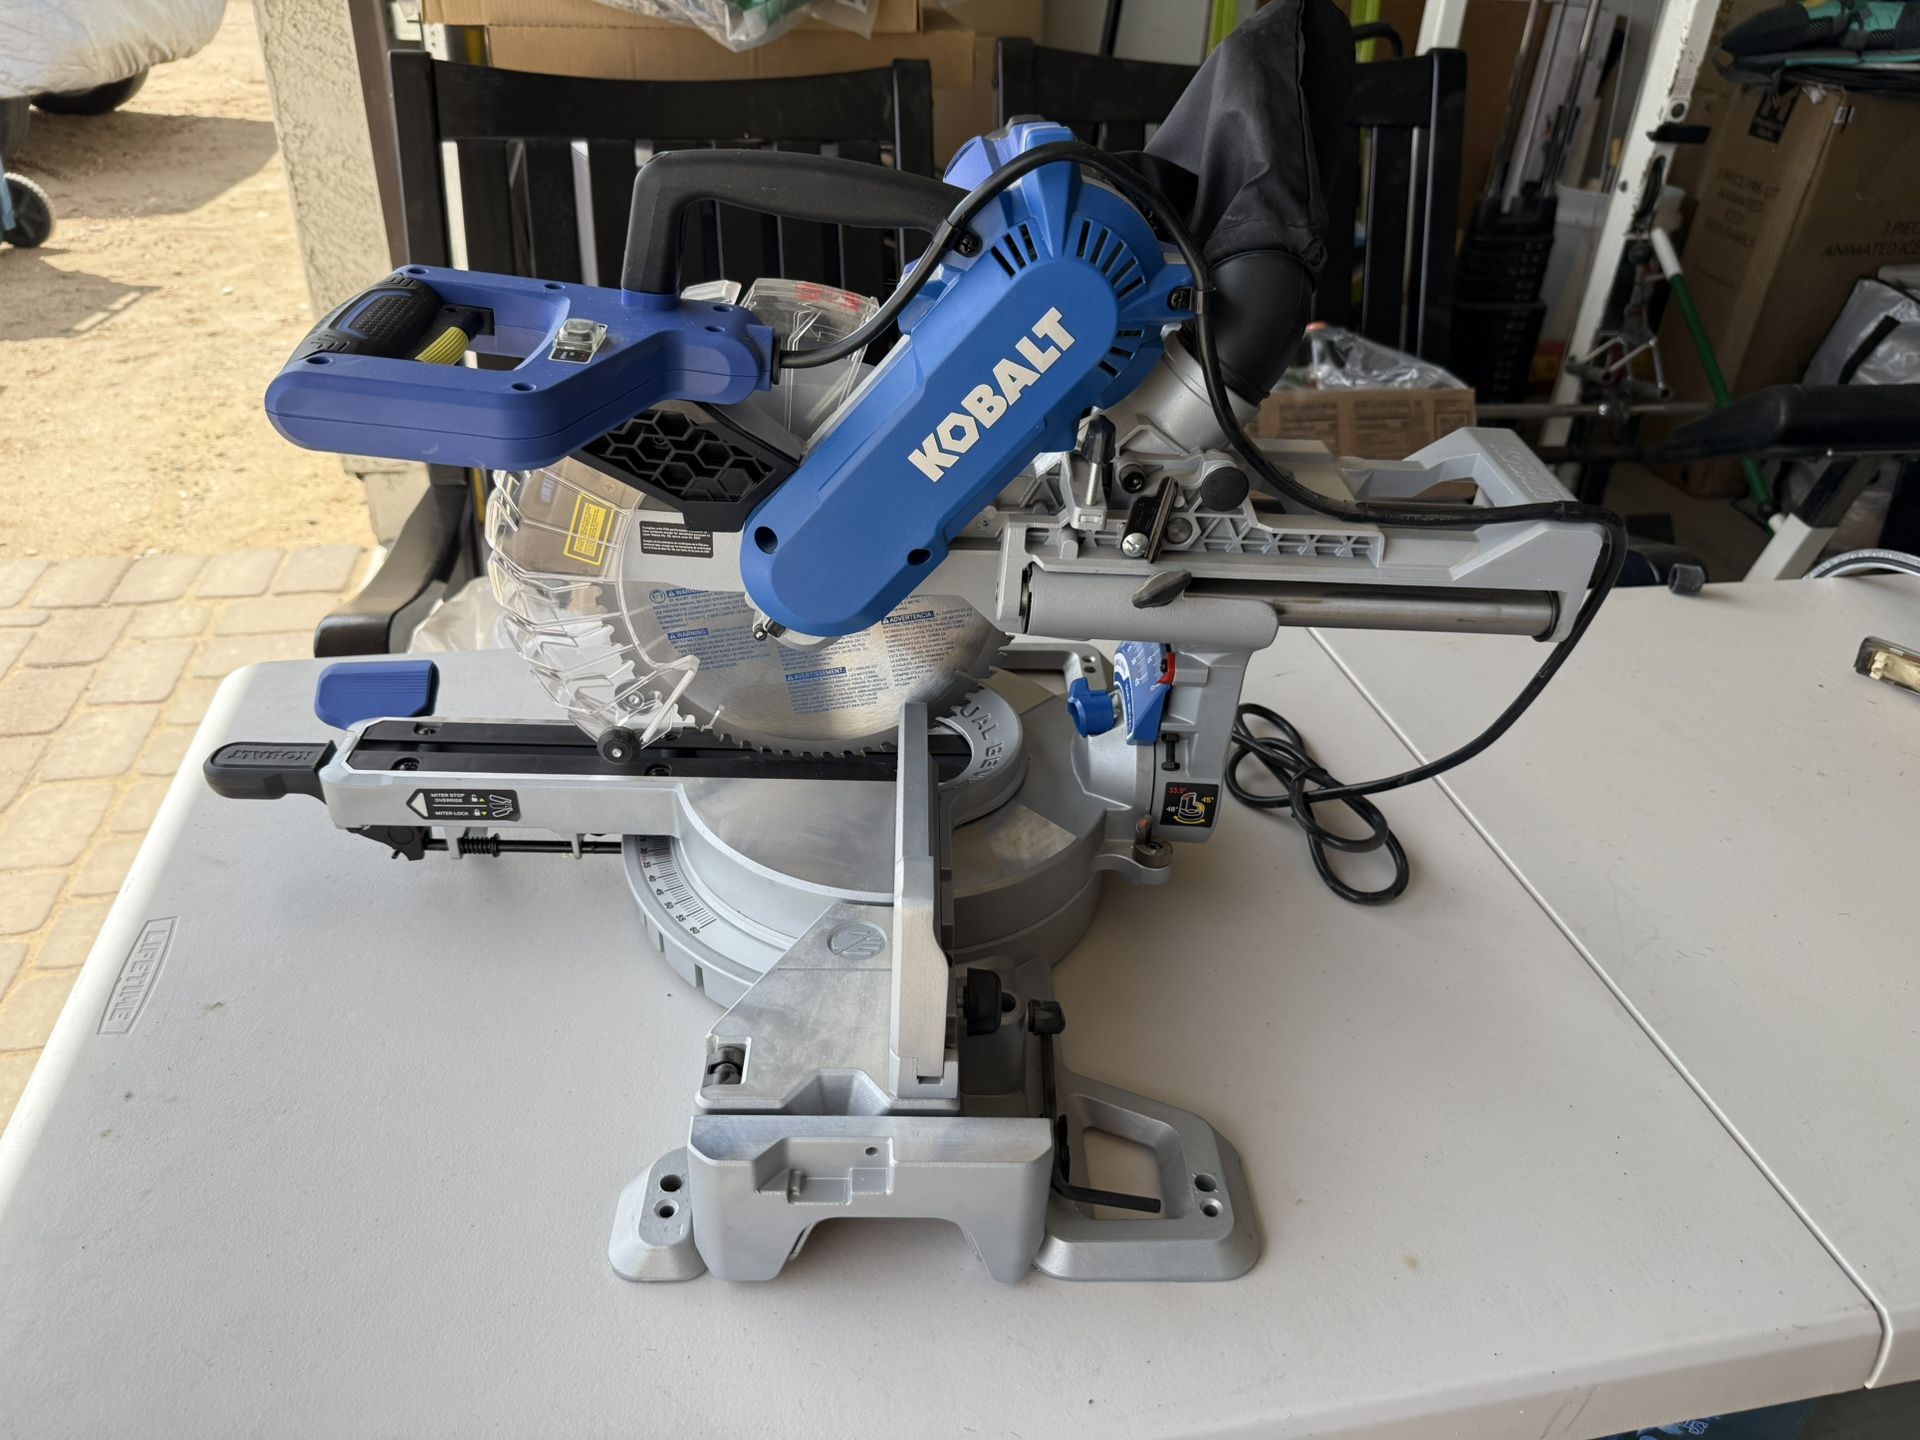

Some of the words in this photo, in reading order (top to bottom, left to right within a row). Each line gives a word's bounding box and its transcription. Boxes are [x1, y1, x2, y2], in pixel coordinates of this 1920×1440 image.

[908, 306, 1076, 483] KOBALT
[793, 667, 845, 680] AVERTISSEMENT:
[228, 749, 316, 764] KOBALT
[643, 861, 651, 869] 35
[648, 875, 657, 883] 40
[656, 888, 665, 896] 45
[664, 901, 674, 909] 50
[675, 914, 686, 922] 55
[689, 926, 701, 935] 60
[114, 928, 168, 1022] LIFETIME
